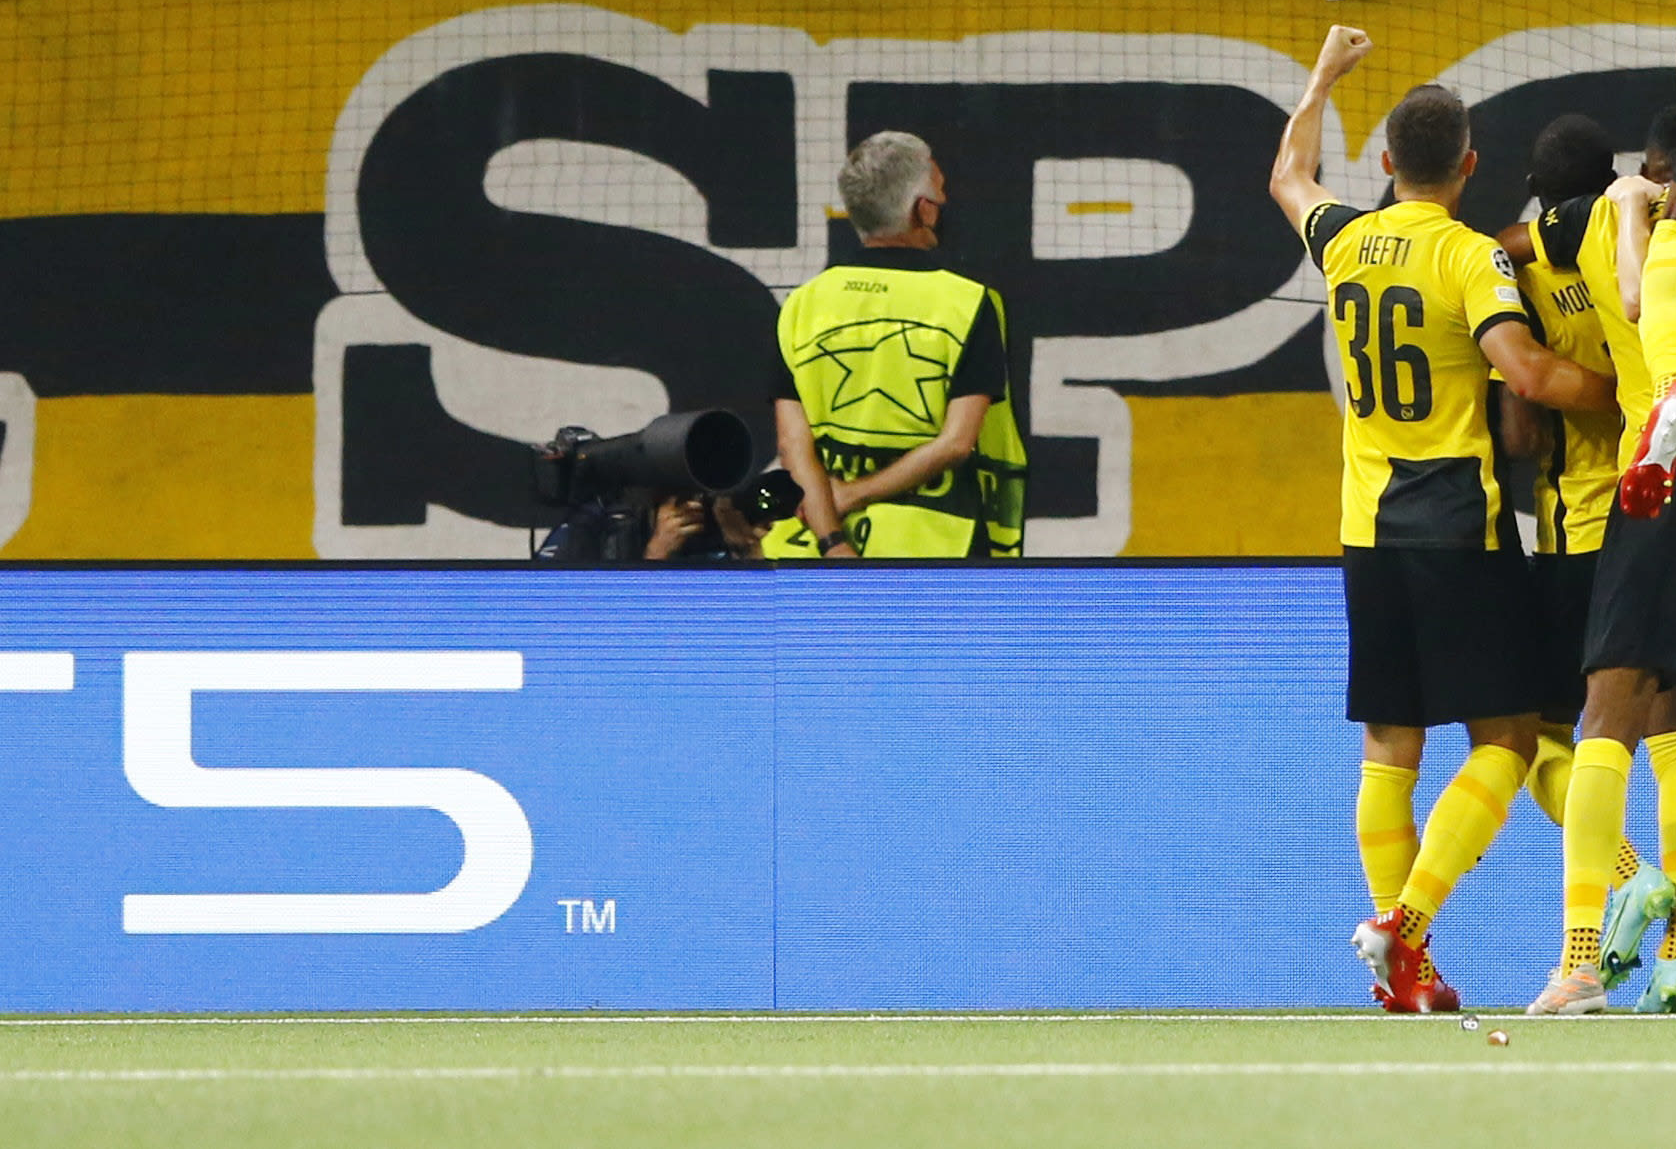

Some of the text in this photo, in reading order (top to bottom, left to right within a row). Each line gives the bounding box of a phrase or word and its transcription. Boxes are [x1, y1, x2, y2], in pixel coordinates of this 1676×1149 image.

[1358, 235, 1412, 267] HEFTI
[1335, 282, 1433, 422] 36
[0, 651, 617, 935] 5 TM
